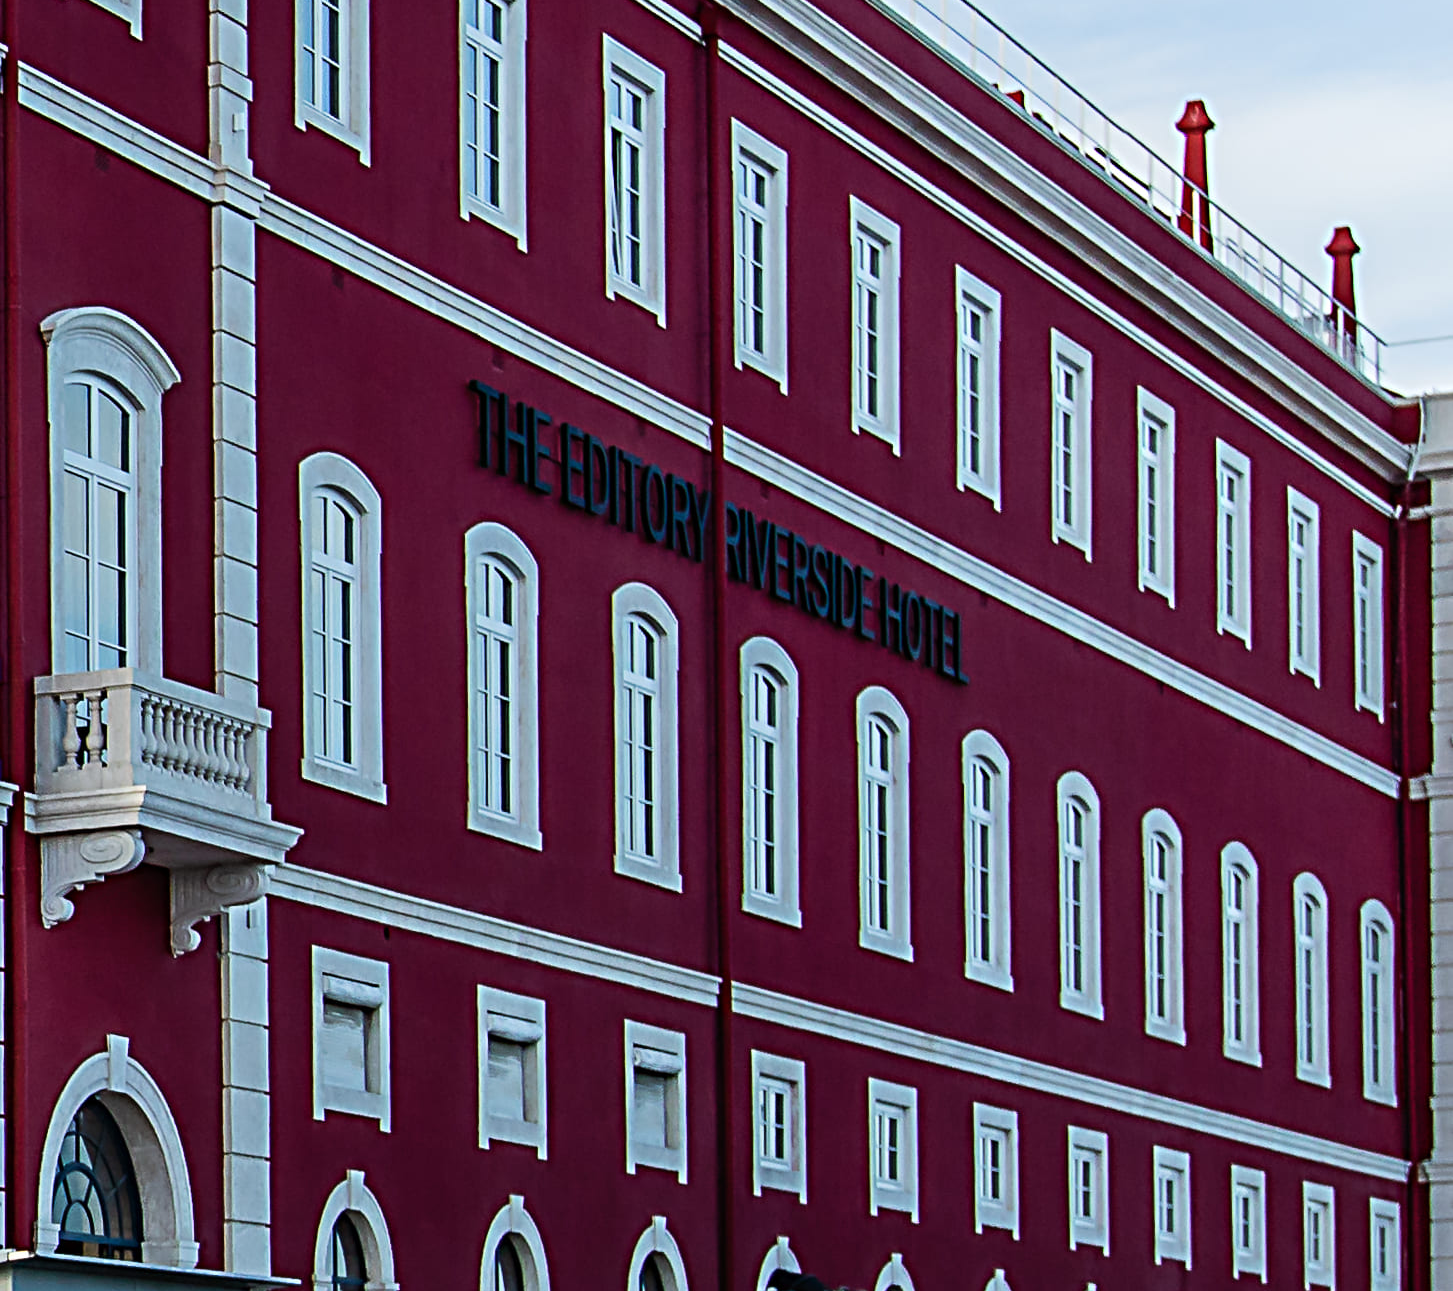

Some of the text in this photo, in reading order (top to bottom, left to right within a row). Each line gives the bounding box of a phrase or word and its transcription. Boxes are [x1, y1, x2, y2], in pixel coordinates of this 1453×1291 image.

[468, 379, 970, 686] THE EDITORY RIVERSIDE HOTEL
